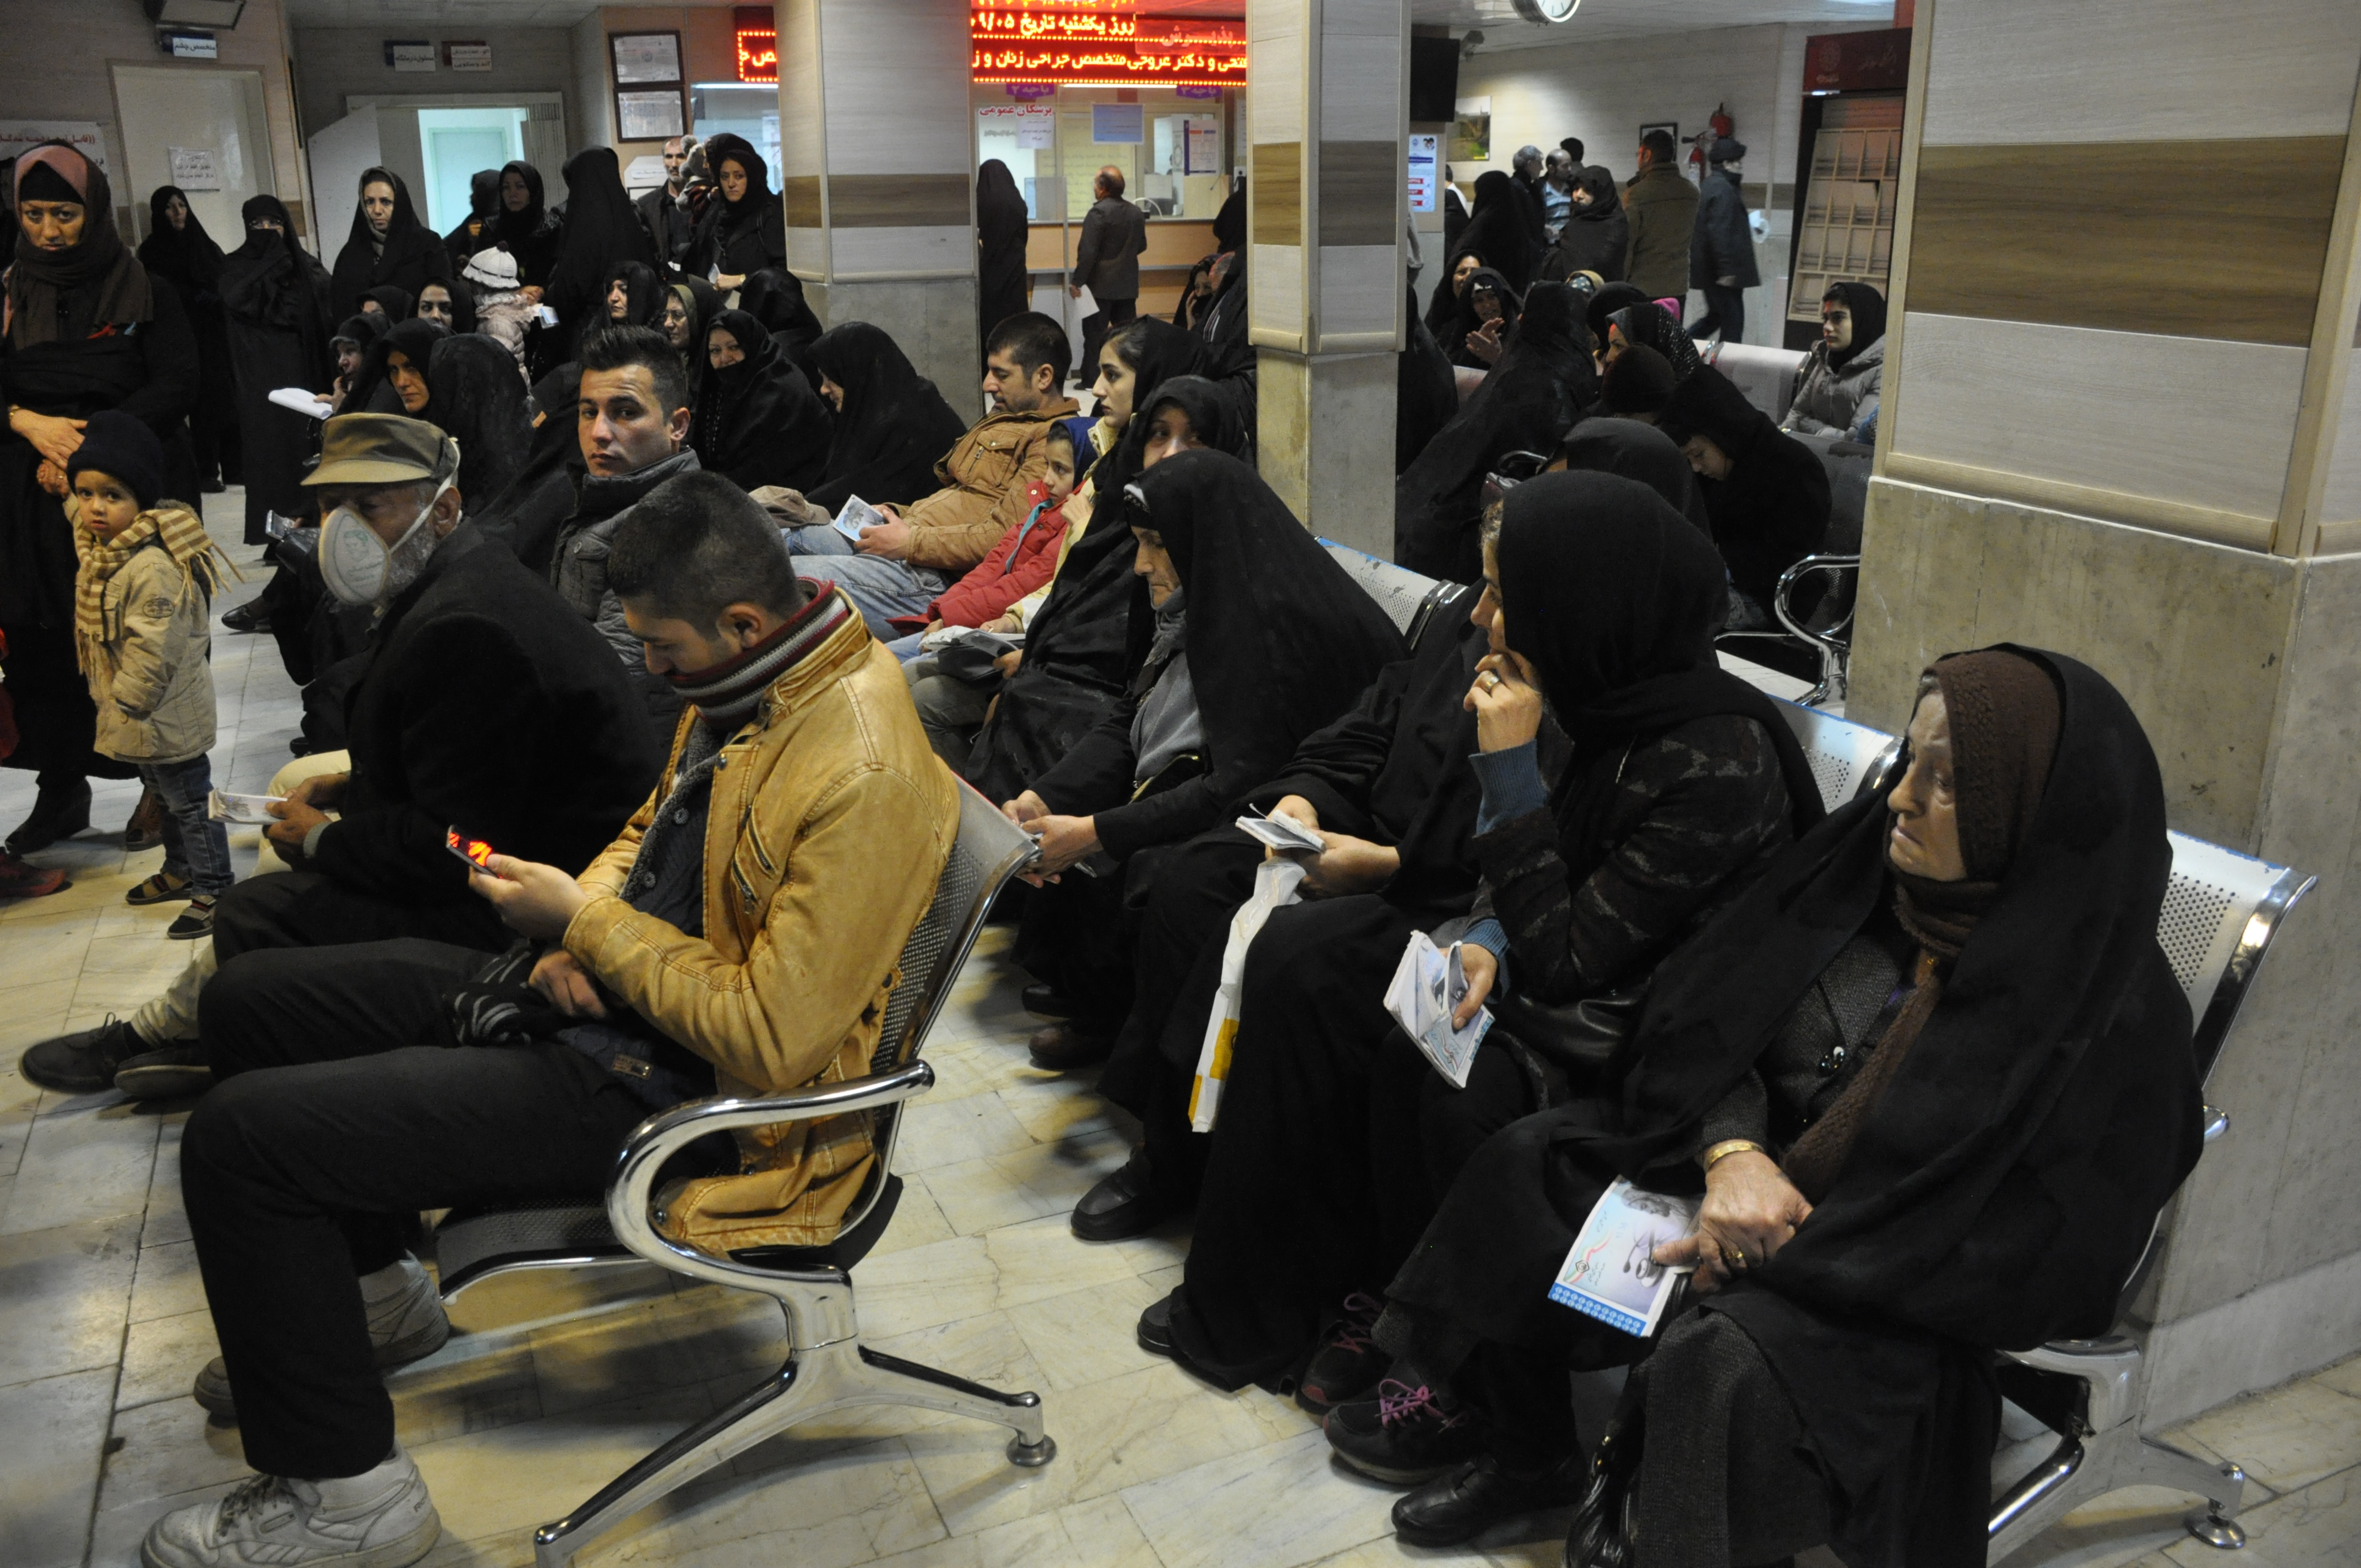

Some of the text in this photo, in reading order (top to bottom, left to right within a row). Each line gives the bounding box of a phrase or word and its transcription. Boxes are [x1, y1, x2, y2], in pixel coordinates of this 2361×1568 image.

[971, 12, 1135, 36] روز یکشنبه تاریخ ۰۹/۰۵
[174, 42, 189, 51] چشم
[395, 54, 417, 63] درمانگاه
[983, 52, 992, 68] و
[995, 51, 1024, 68] زنان
[1026, 52, 1070, 69] جراحی
[1071, 52, 1126, 69] متخصص
[1127, 56, 1171, 70] عروجی
[1173, 53, 1204, 71] دکتر
[1207, 58, 1215, 72] و
[1022, 85, 1049, 96] باجه
[1191, 86, 1216, 97] باجه
[979, 104, 1053, 117] پزشکان عمومی
